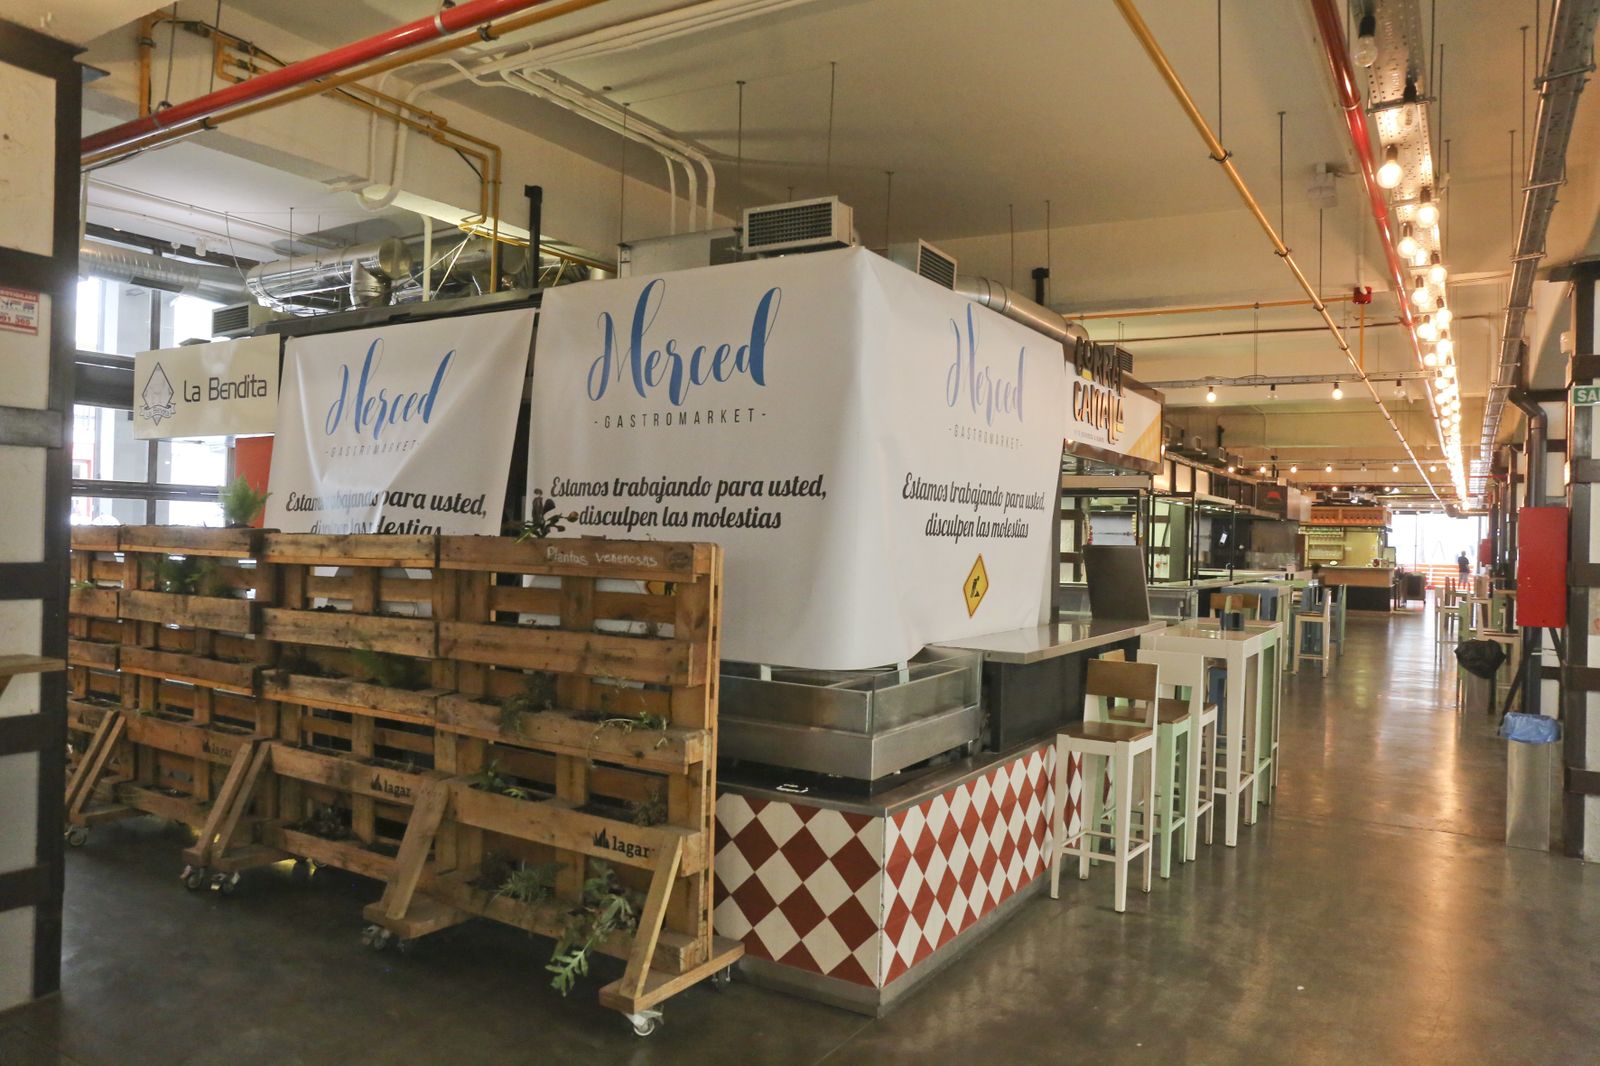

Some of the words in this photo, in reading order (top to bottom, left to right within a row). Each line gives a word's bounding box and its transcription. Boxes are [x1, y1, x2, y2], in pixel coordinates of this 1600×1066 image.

[587, 278, 782, 406] Merced
[946, 302, 1026, 428] Merced
[183, 379, 201, 403] La
[208, 374, 268, 401] Bendita
[325, 337, 457, 441] Merced
[1577, 389, 1600, 402] SA
[550, 476, 609, 498] Estamos
[612, 475, 711, 503] trabajando
[715, 478, 764, 503] para
[768, 474, 827, 500] usted,
[902, 472, 948, 502] Estamos
[949, 481, 1004, 512] trabajando
[1003, 490, 1025, 514] para
[430, 493, 488, 519] usted,
[578, 505, 658, 532] disculpen
[662, 506, 689, 528] las
[691, 506, 782, 529] molestias
[925, 512, 975, 544] disculpen
[976, 515, 990, 538] las
[990, 517, 1029, 539] molestias
[546, 545, 589, 566] Plantas
[384, 779, 411, 798] lagar
[612, 836, 650, 858] lagar
